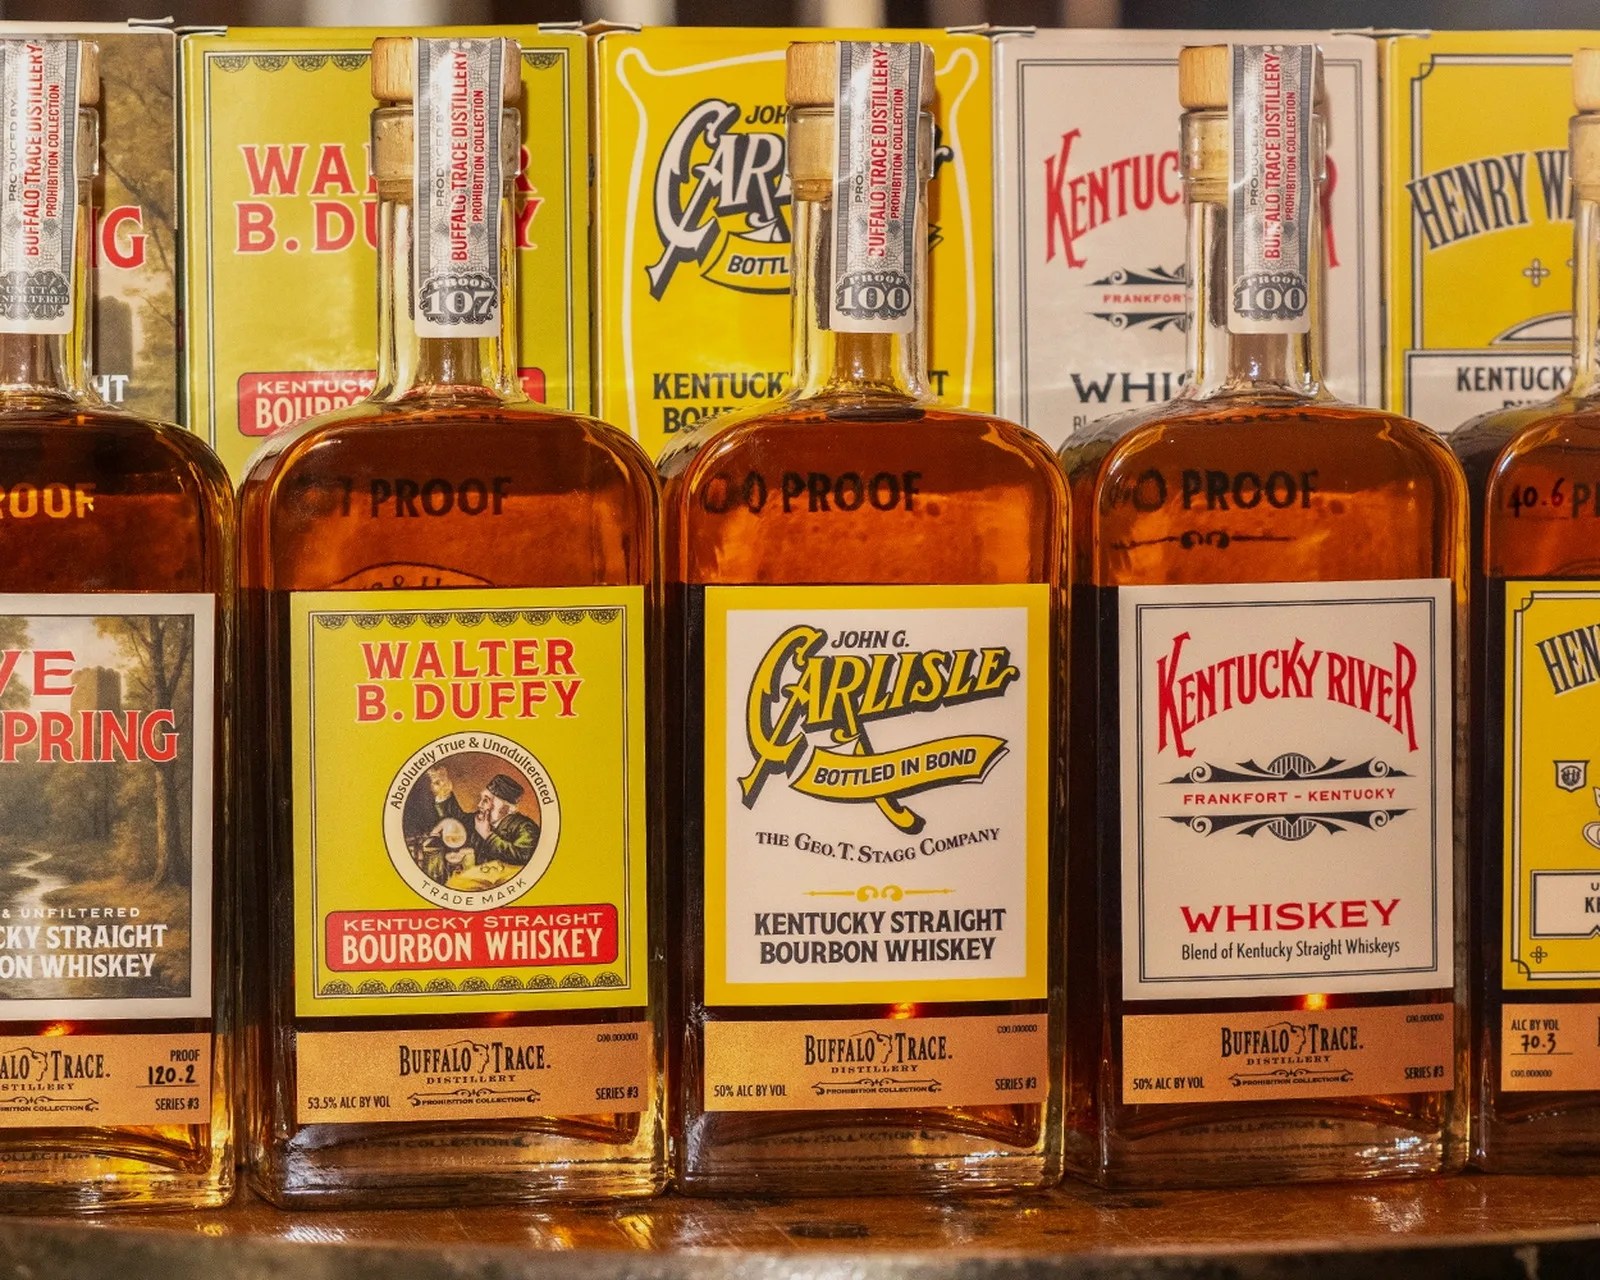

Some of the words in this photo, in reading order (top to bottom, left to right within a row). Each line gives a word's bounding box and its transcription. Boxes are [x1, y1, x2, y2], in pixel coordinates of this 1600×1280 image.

[26, 44, 43, 132] DISTILLERY
[451, 51, 468, 138] DISTILLERY
[872, 49, 888, 135] DISTILLERY
[1264, 53, 1280, 138] DISTILLERY
[48, 84, 60, 148] COLLECTION
[473, 90, 485, 153] COLLECTION
[745, 105, 792, 124] JOH
[893, 88, 903, 150] COLLECTION
[1286, 91, 1297, 153] COLLECTION
[24, 137, 42, 186] TRACE
[450, 142, 468, 190] TRACE
[871, 139, 887, 187] TRACE
[1265, 143, 1281, 189] TRACE
[45, 151, 59, 218] PROHIBITION
[472, 156, 485, 222] PROHIBITION
[891, 153, 904, 219] PROHIBITION
[1044, 128, 1188, 269] KENTUC
[1285, 153, 1297, 221] PROHIBITION
[1406, 152, 1530, 249] HENRY
[1534, 150, 1574, 221] W
[23, 190, 41, 256] BUFFALO
[450, 194, 468, 261] BUFFALO
[432, 278, 492, 290] PROOF
[849, 274, 904, 285] PROOF
[1246, 275, 1301, 286] PROOF
[425, 290, 496, 315] 107
[838, 286, 911, 311] 100
[1236, 287, 1307, 311] 100
[653, 371, 786, 400] KENTUCK
[1456, 366, 1573, 391] KENTUCK
[370, 477, 512, 518] PROOF
[782, 471, 922, 513] PROOF
[1181, 469, 1319, 511] PROOF
[831, 630, 889, 649] JOHN
[892, 630, 910, 648] G.
[360, 638, 578, 680] WALTER
[413, 679, 585, 722] DUFFY
[1156, 631, 1324, 758] KENTUCKY
[1326, 641, 1420, 753] RIVER
[737, 624, 1020, 812] CARLISLE
[390, 750, 437, 810] Absolutely
[435, 737, 466, 756] True
[468, 736, 480, 749] &
[483, 738, 555, 805] Unadulterated
[814, 763, 895, 786] BOTTLED
[901, 757, 920, 776] IN
[926, 748, 977, 771] BOND
[1183, 791, 1288, 806] FRANKFORT
[1308, 788, 1396, 802] KENTUCKY
[755, 831, 789, 847] THE
[857, 845, 916, 864] STAGG
[919, 828, 1001, 856] COMPANY
[421, 879, 475, 906] TRADE
[482, 877, 527, 905] MARK
[2, 909, 11, 919] &
[21, 907, 141, 919] UNFILTERED
[343, 916, 475, 932] KENTUCKY
[483, 912, 604, 929] STRAIGHT
[754, 910, 886, 936] KENTUCKY
[890, 908, 1007, 933] STRAIGHT
[1179, 898, 1401, 933] WHISKEY
[46, 923, 168, 950] STRAIGHT
[342, 931, 473, 965] BOURBON
[484, 927, 604, 961] WHISKEY
[759, 940, 878, 965] BOURBON
[884, 937, 997, 962] WHISKEY
[1181, 943, 1217, 960] Blend
[1221, 942, 1234, 958] of
[1236, 941, 1293, 962] Kentucky
[1296, 939, 1343, 961] Straight
[1345, 937, 1401, 957] Whiskeys
[41, 953, 157, 978] WHISKEY
[1511, 1019, 1527, 1031] ALC
[1529, 1019, 1541, 1031] BY
[1543, 1019, 1560, 1031] VOL
[170, 1049, 201, 1062] PROOF
[804, 1034, 875, 1065] BUFFALO
[1221, 1027, 1290, 1057] BUFFALO
[1521, 1032, 1557, 1055] 70.3
[148, 1064, 196, 1085] 120.2
[399, 1045, 472, 1076] BUFFALO
[831, 1064, 919, 1074] DISTILLERY
[1246, 1055, 1331, 1066] DISTILLERY
[1404, 1067, 1432, 1080] SERIES
[1433, 1066, 1444, 1078] #3
[426, 1074, 517, 1085] DISTILLERY
[595, 1087, 625, 1100] SERIES
[627, 1086, 639, 1099] #3
[714, 1084, 734, 1098] 50%
[736, 1085, 753, 1097] ALC
[755, 1085, 768, 1097] BY
[770, 1084, 788, 1097] VOL
[826, 1087, 876, 1095] PROHIBITION
[878, 1086, 928, 1094] COLLECTION
[995, 1078, 1024, 1091] SERIES
[1025, 1076, 1037, 1089] #3
[1133, 1078, 1153, 1090] 50%
[1155, 1077, 1172, 1089] ALC
[1174, 1077, 1186, 1089] BY
[1187, 1076, 1205, 1089] VOL
[1242, 1078, 1291, 1086] PROHIBITION
[1292, 1076, 1340, 1084] COLLECTION
[155, 1098, 185, 1111] SERIES
[186, 1097, 200, 1110] #3
[307, 1096, 338, 1109] 53.5%
[339, 1096, 357, 1108] ALC
[359, 1096, 372, 1108] BY
[373, 1095, 391, 1108] VOL
[475, 1096, 526, 1104] COLLECTION
